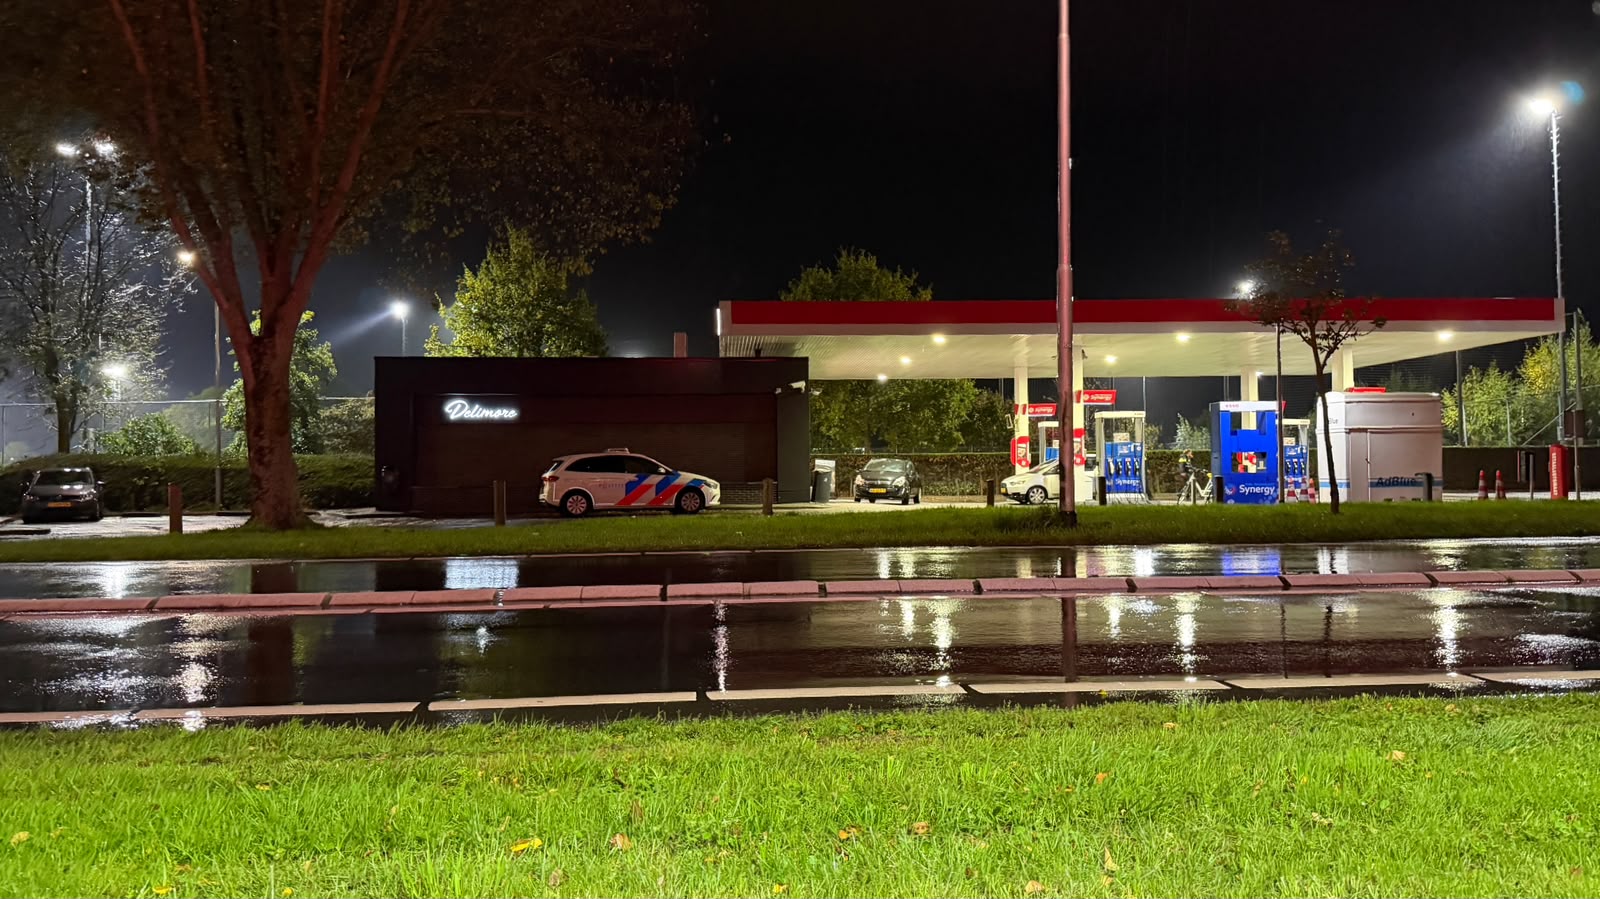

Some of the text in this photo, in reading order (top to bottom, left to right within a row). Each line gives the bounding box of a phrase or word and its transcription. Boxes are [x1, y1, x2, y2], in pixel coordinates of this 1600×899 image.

[444, 399, 518, 420] Delimore
[1377, 476, 1415, 487] AdBlue
[1239, 484, 1275, 496] Synergy
